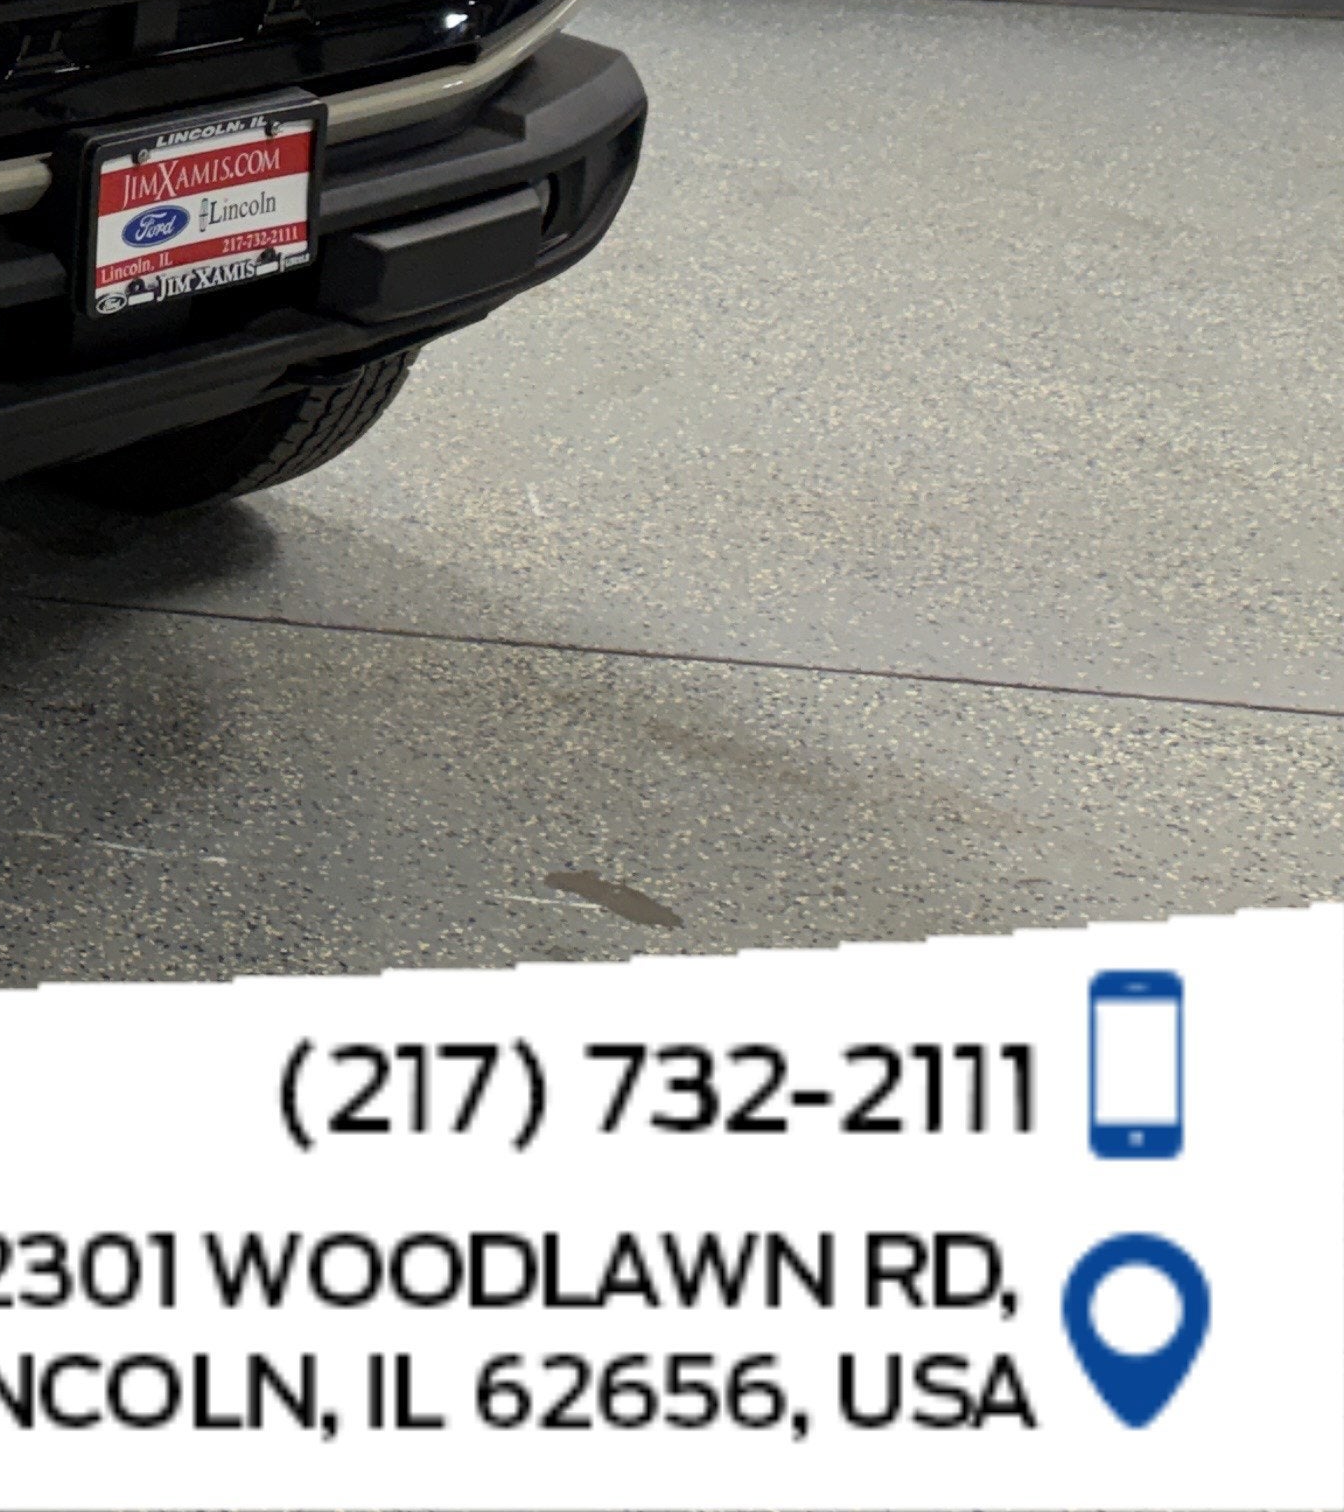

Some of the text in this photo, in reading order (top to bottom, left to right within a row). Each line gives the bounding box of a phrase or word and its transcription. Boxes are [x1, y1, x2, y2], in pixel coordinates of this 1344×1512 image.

[155, 119, 245, 147] LINCOLN,
[123, 147, 281, 209] JIMXAMIS.COM
[135, 191, 276, 242] Ford Lincoln
[222, 225, 298, 254] 217-732-2111
[159, 252, 174, 267] IL
[156, 261, 256, 302] JIM XAMIS
